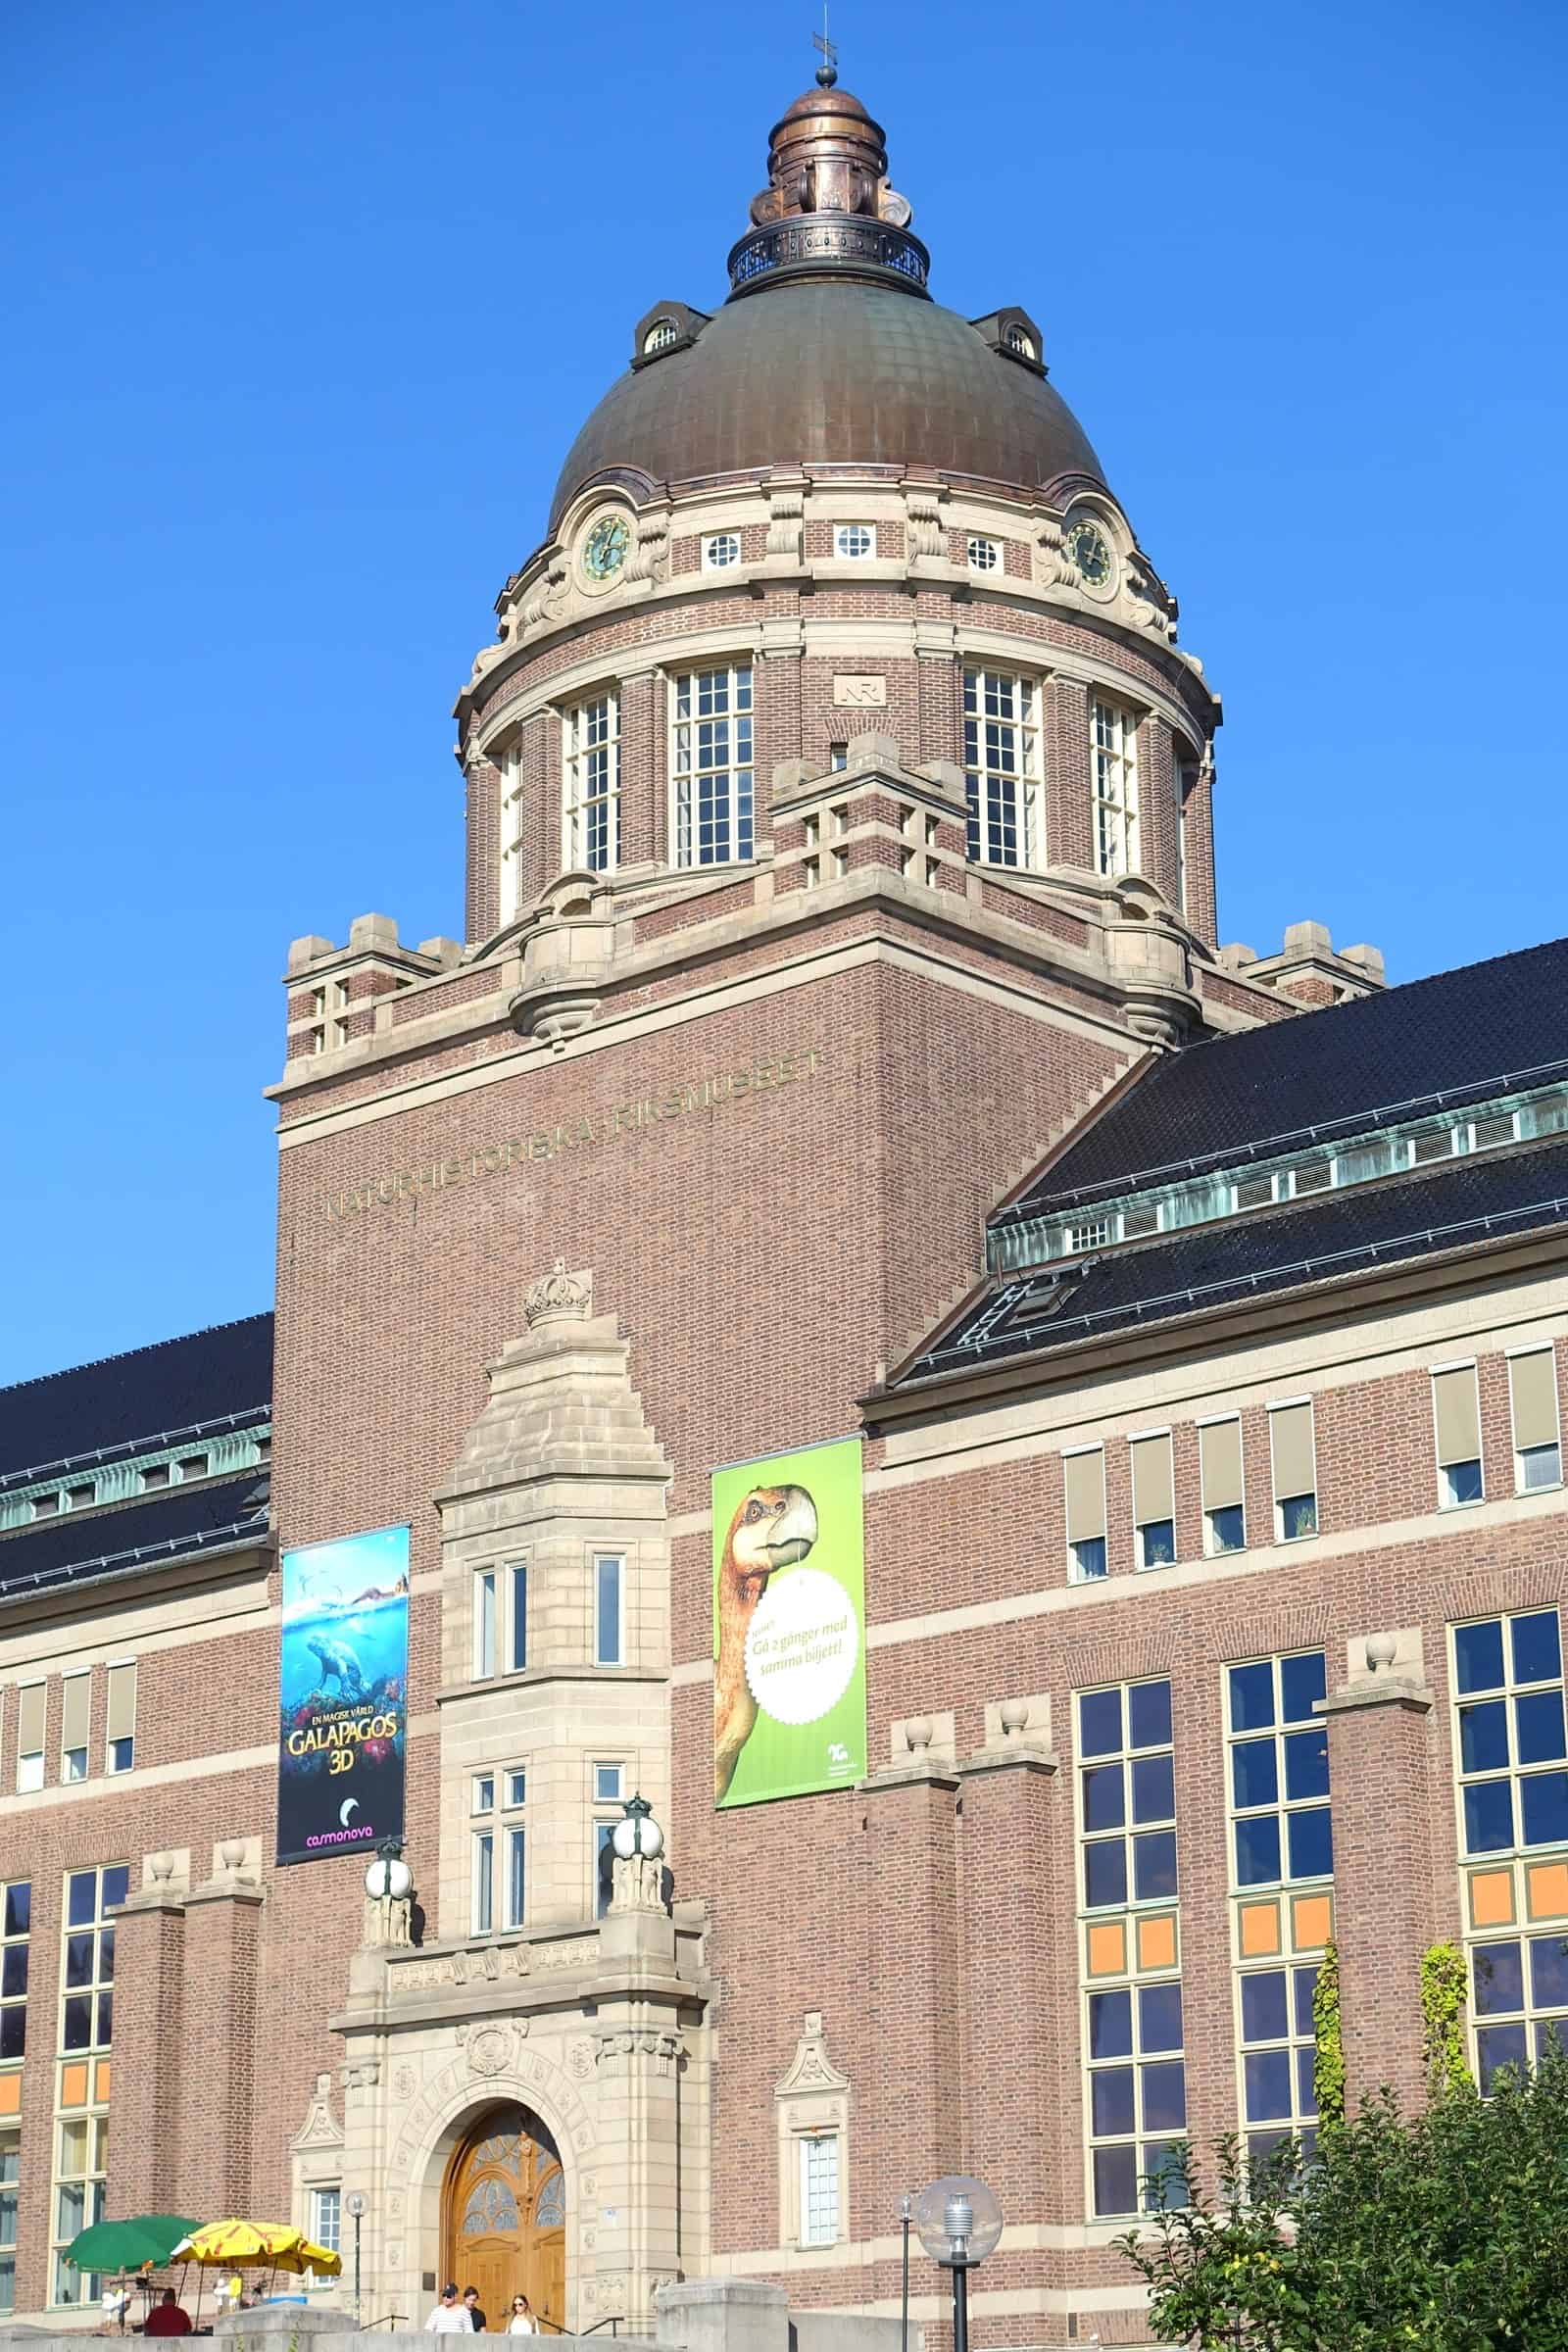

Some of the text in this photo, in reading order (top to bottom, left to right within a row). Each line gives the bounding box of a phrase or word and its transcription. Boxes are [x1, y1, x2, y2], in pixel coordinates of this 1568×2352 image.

[324, 1048, 824, 1223] NATURHISTORISKA RIKSMUSEET
[822, 1614, 848, 1636] med
[760, 1653, 804, 1677] samma
[312, 1714, 322, 1725] EN
[322, 1709, 351, 1724] MAGISK
[288, 1712, 398, 1756] GALAPAGOS
[328, 1748, 355, 1776] 3D
